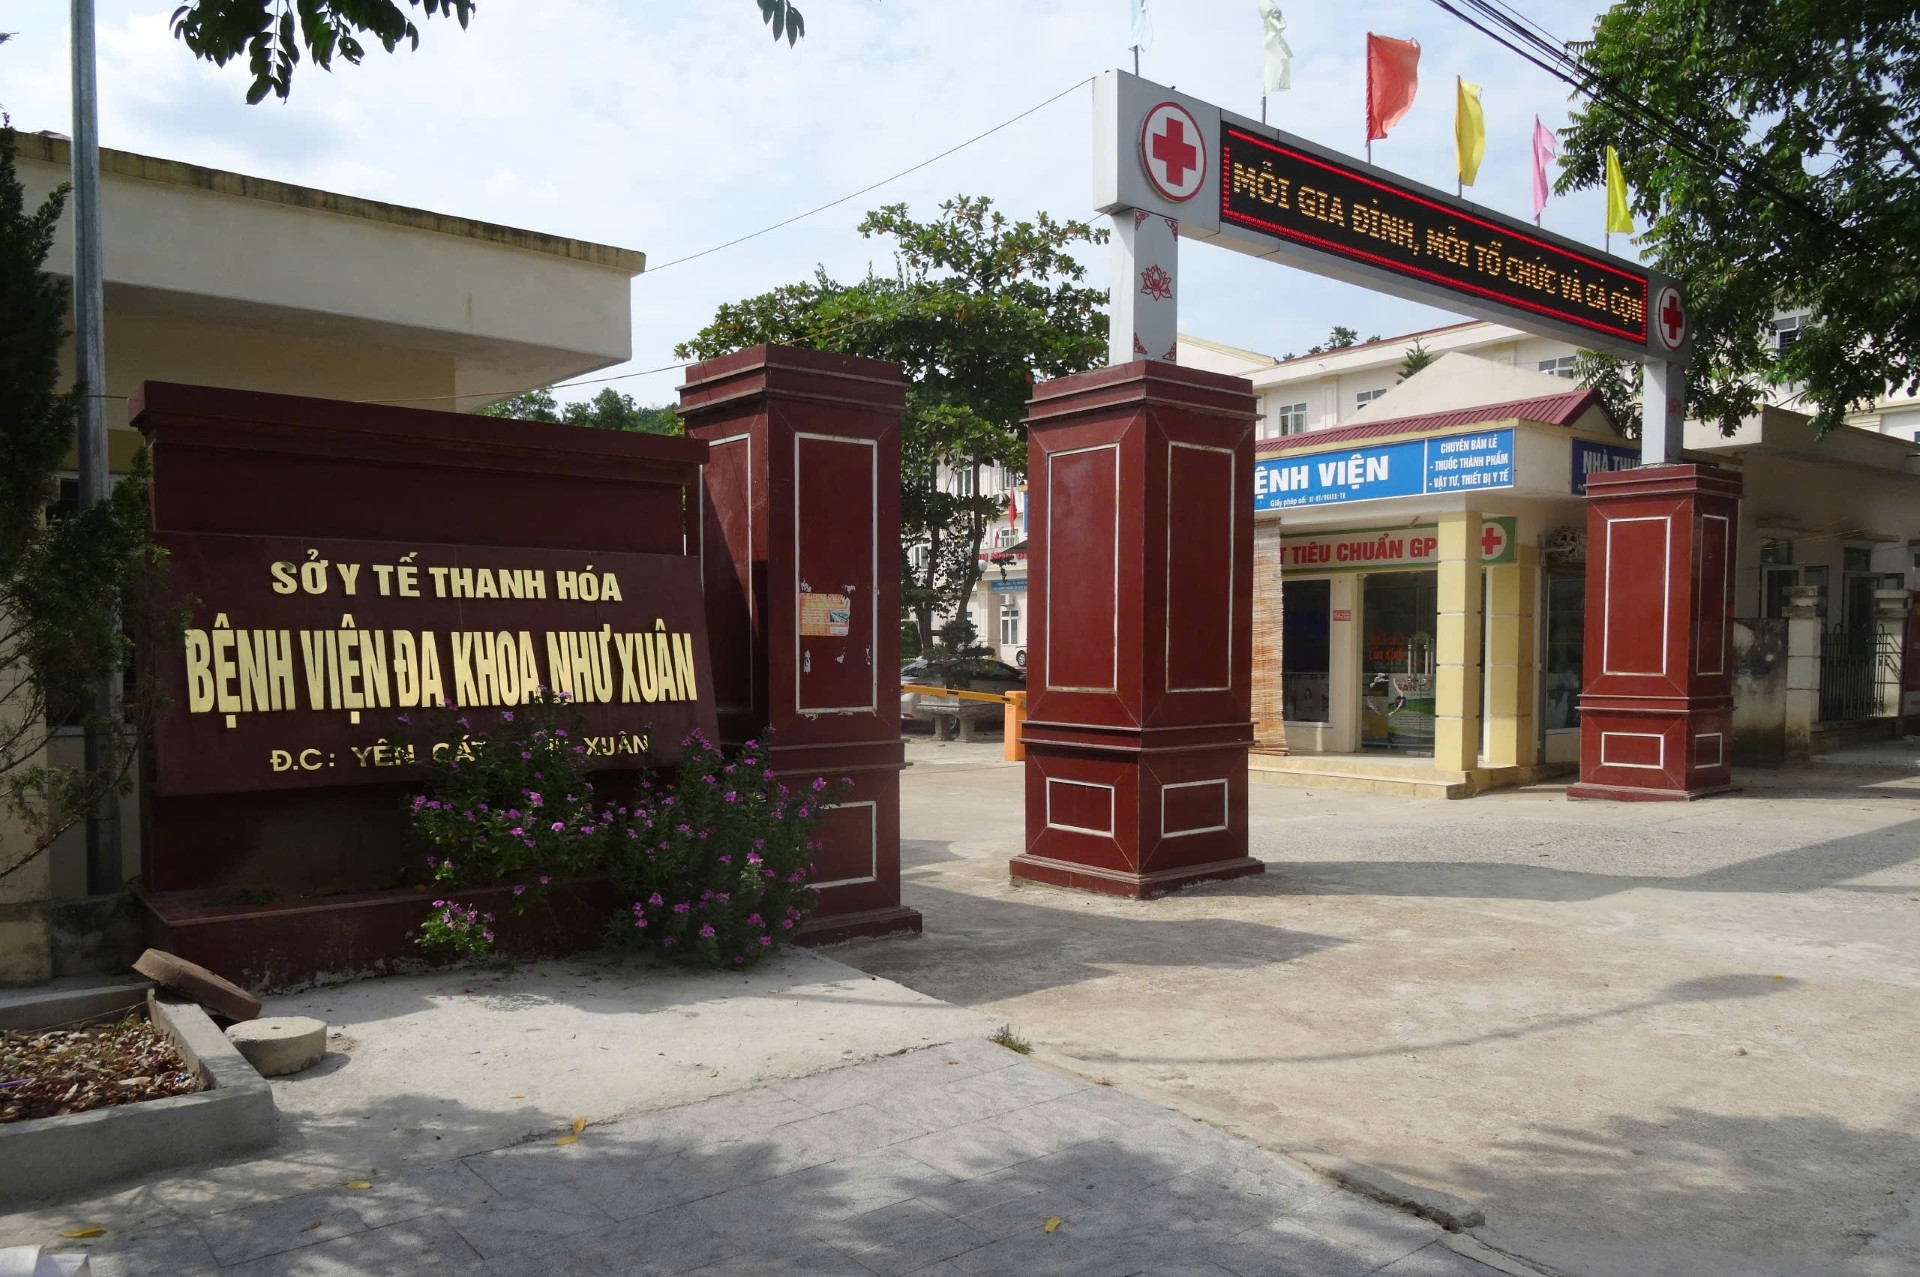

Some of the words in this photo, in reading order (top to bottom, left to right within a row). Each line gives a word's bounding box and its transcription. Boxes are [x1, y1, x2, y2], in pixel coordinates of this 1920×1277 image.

[1234, 160, 1290, 209] MỖI
[1298, 186, 1345, 227] GIA
[1427, 225, 1469, 267] MỖI
[1505, 256, 1556, 294] CHỨC
[1435, 456, 1458, 471] THUỐC
[1459, 455, 1484, 469] THÀNH
[1485, 450, 1508, 466] PHẨM
[1441, 438, 1469, 454] CHUYÊN
[1471, 437, 1486, 450] BÁN
[1488, 434, 1497, 448] LẺ
[1254, 466, 1309, 499] ỆNH
[1317, 453, 1389, 489] VIỆN
[1434, 475, 1447, 489] VẬT
[1461, 471, 1481, 485] THIẾT
[1483, 473, 1491, 485] BỊ
[1493, 472, 1498, 482] Y
[1499, 468, 1509, 482] TẾ
[1583, 449, 1608, 474] NHÀ
[1292, 541, 1330, 564] TIÊU
[1337, 533, 1403, 561] CHUẨN
[1409, 537, 1438, 557] GP
[271, 549, 329, 594] SỞ
[336, 564, 361, 595] Y
[373, 552, 420, 597] TẾ
[429, 567, 546, 599] THANH
[556, 565, 623, 601] HÓA
[185, 613, 296, 728] BỆNH
[300, 613, 391, 724] VIỆN
[393, 630, 446, 707] ĐA
[451, 630, 543, 707] KHOA
[546, 624, 613, 705] NHƯ
[614, 618, 698, 703] XUÂN
[350, 738, 415, 768] YÊN
[583, 730, 648, 756] XUÂN
